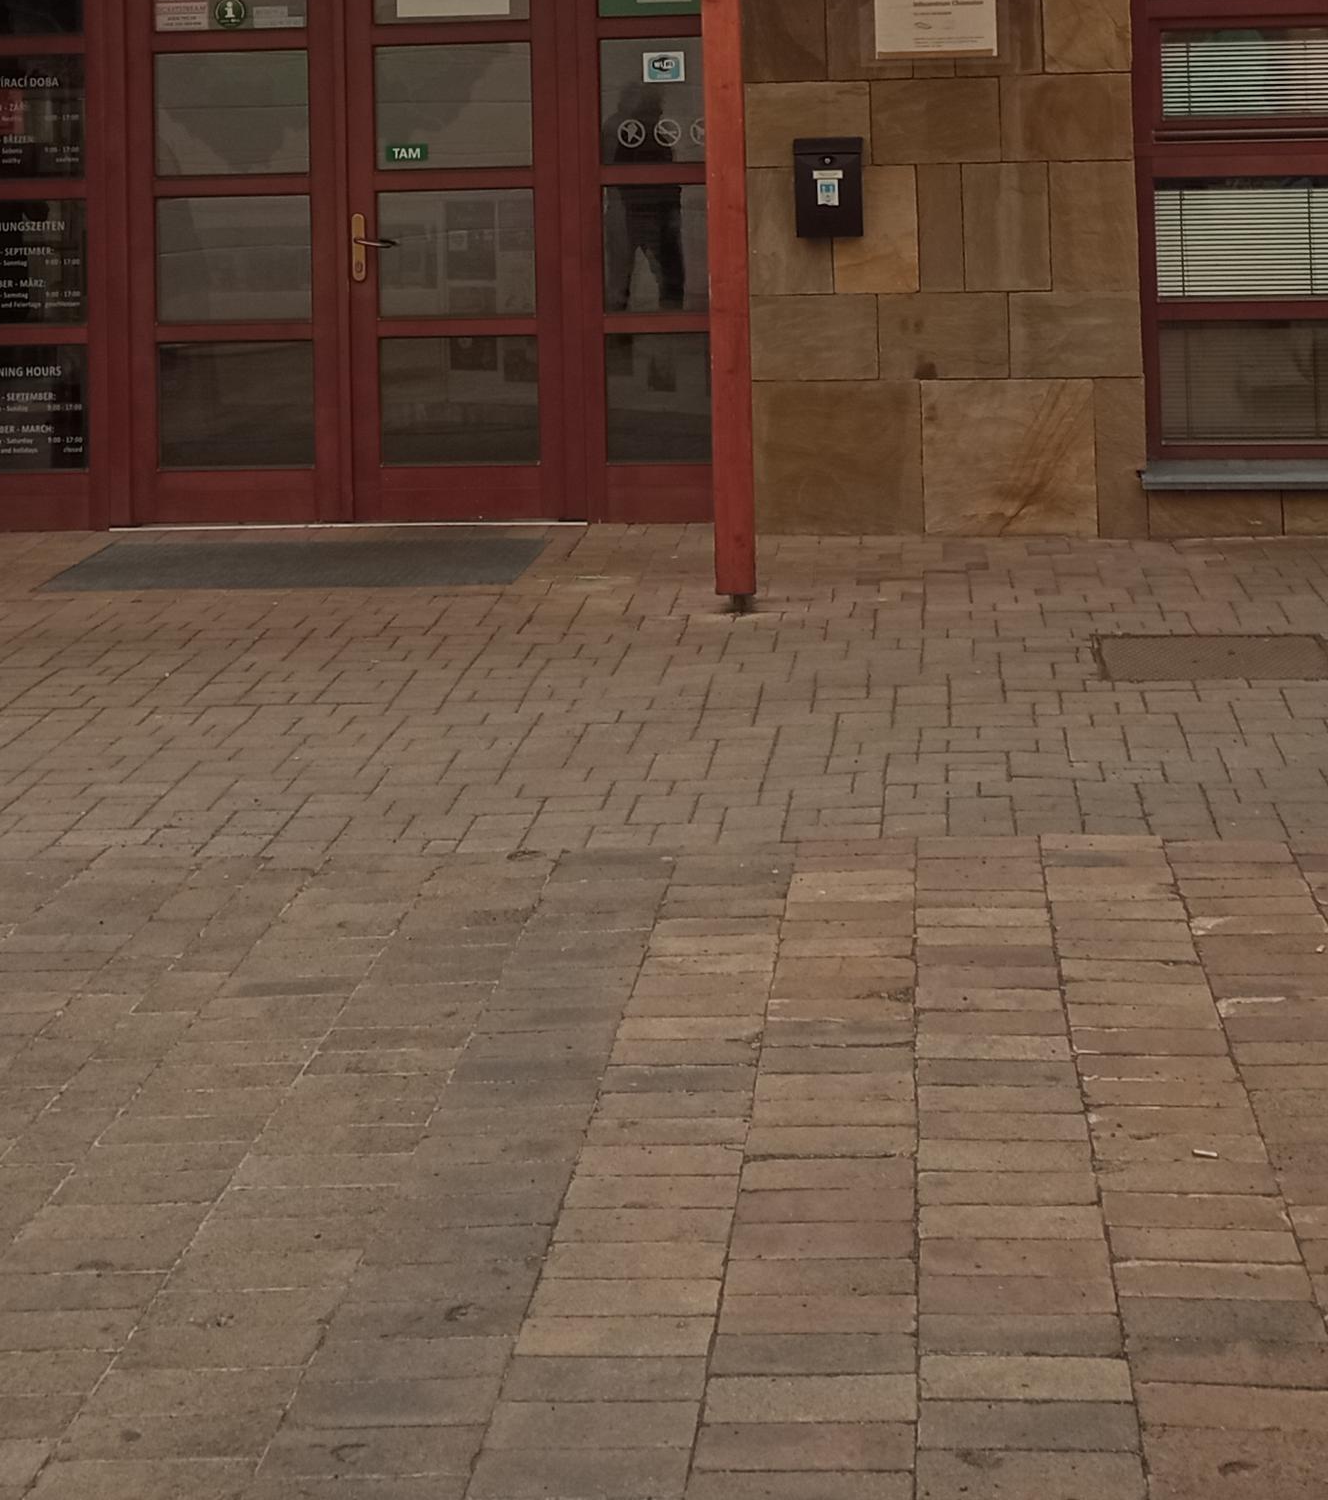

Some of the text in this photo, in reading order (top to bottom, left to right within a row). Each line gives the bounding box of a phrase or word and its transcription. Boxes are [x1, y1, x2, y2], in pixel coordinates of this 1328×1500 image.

[29, 77, 60, 88] DOBA
[392, 147, 421, 160] TAM
[25, 365, 63, 378] HOURS
